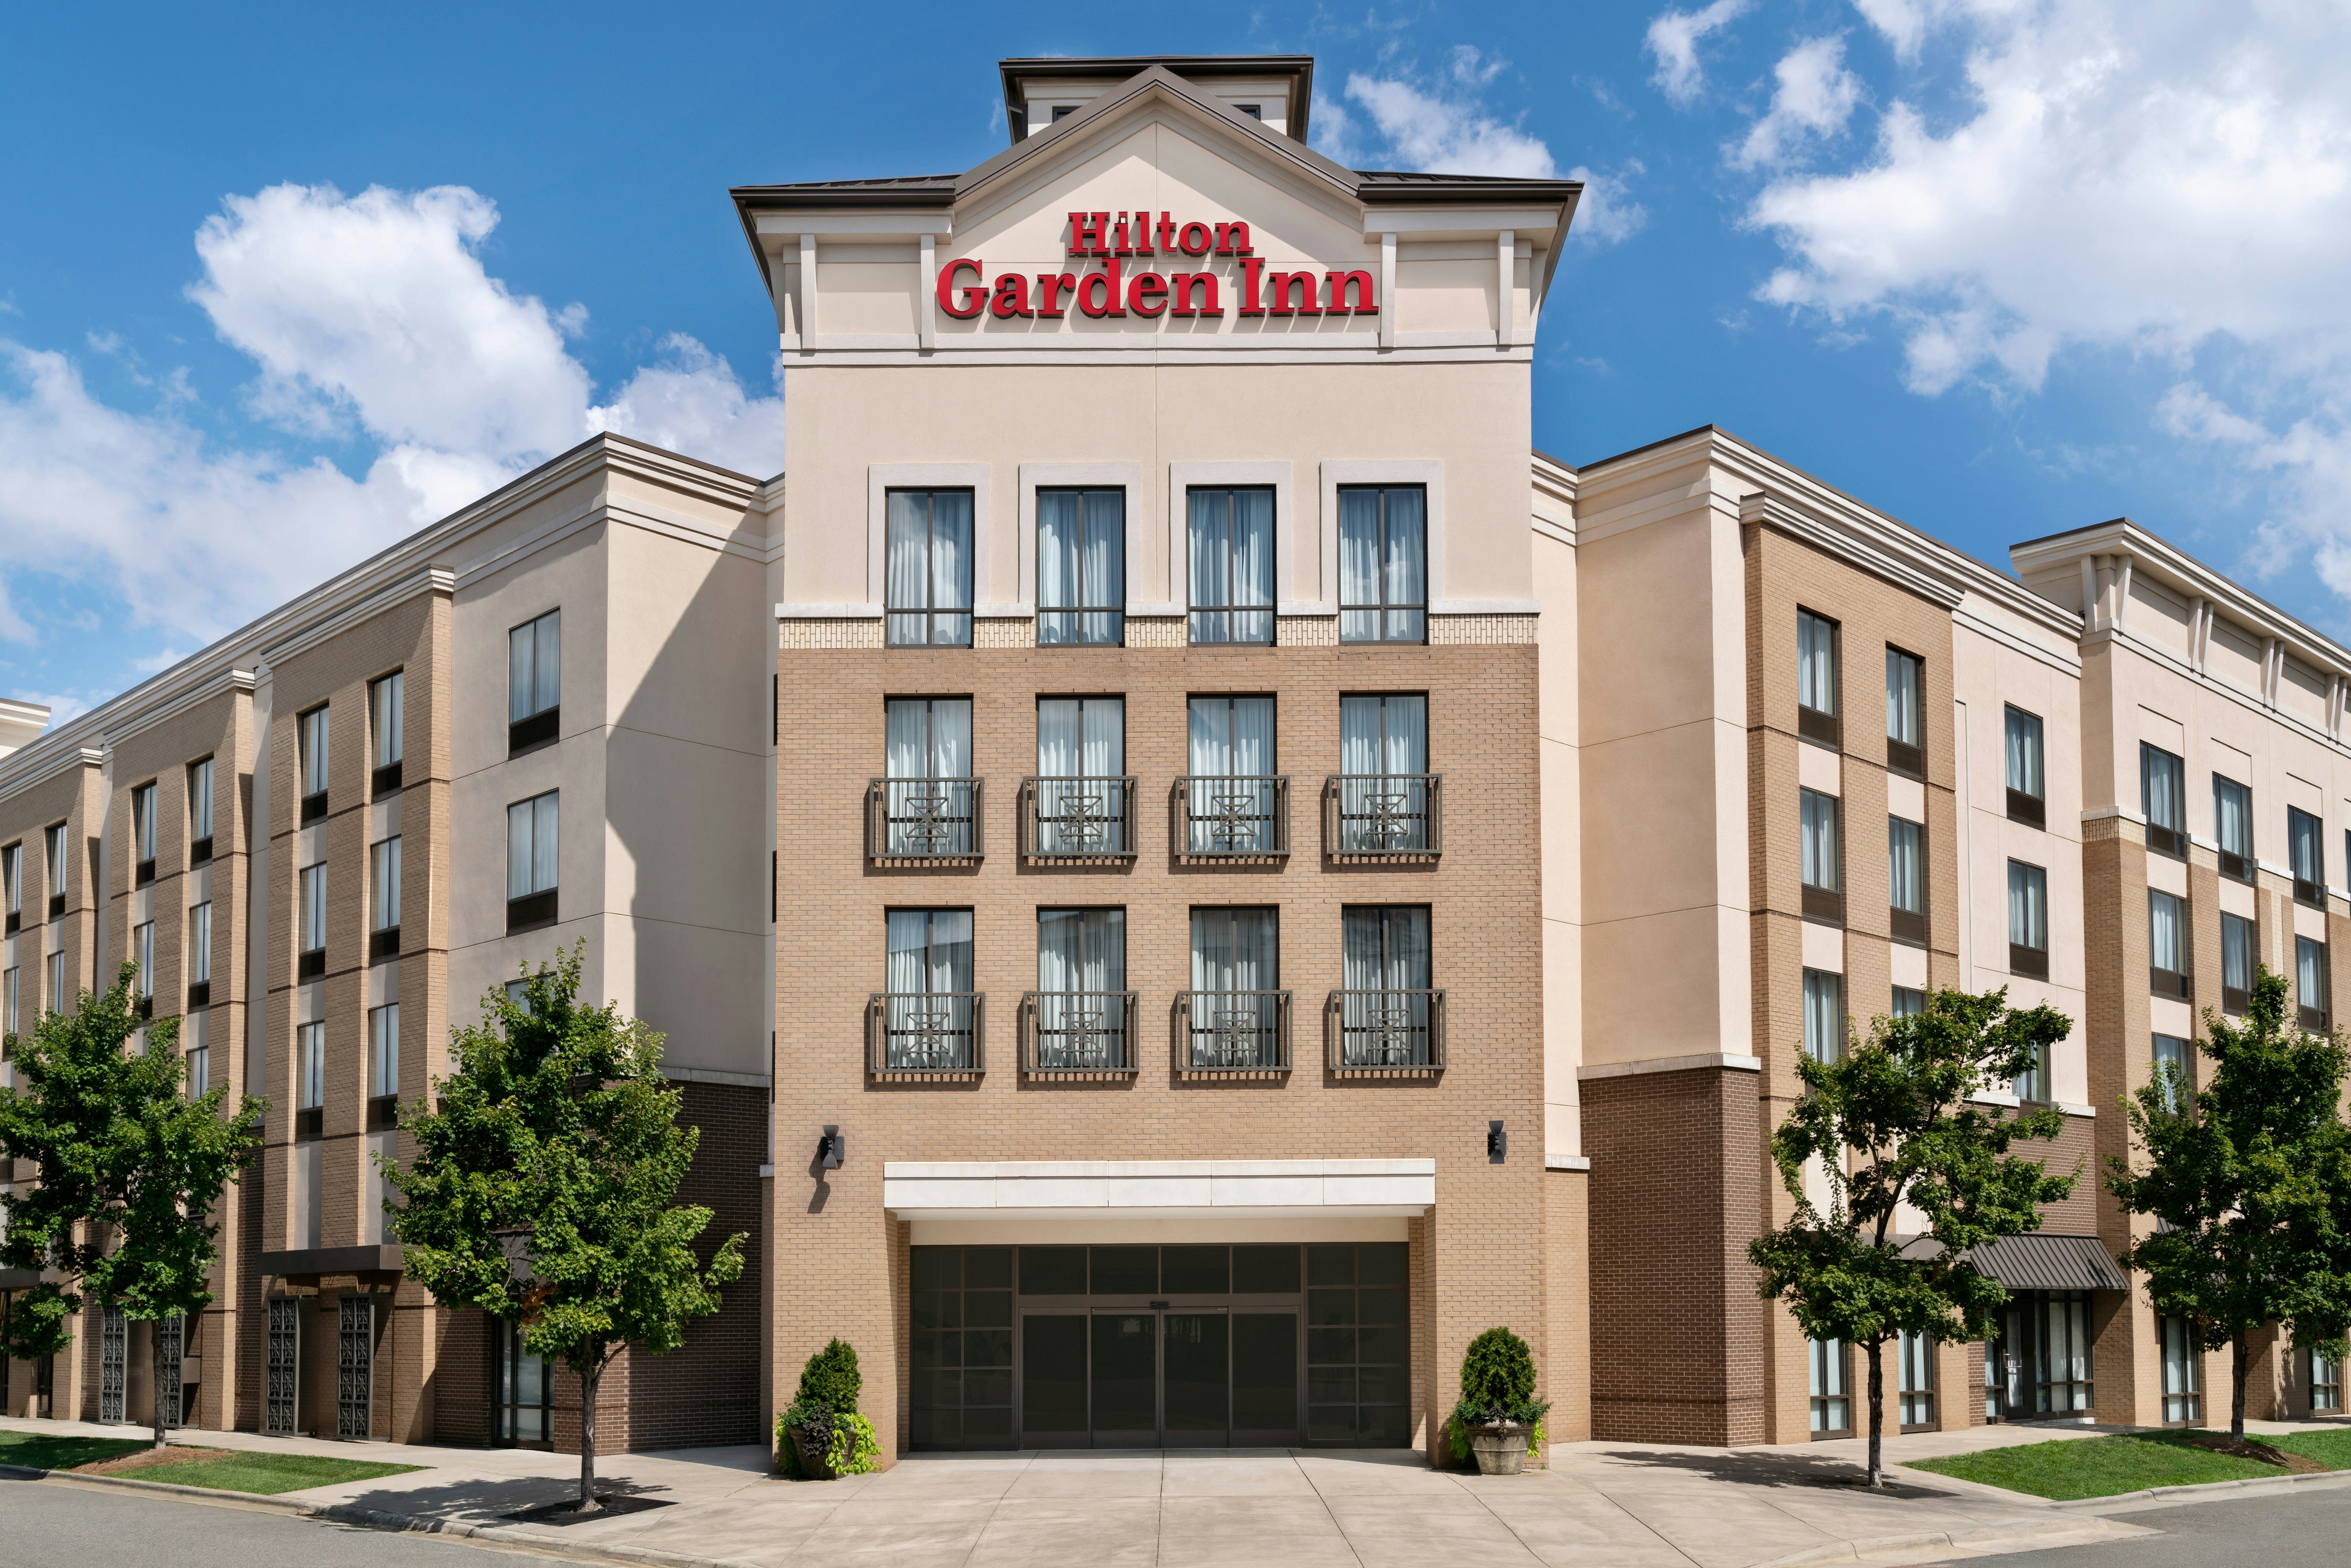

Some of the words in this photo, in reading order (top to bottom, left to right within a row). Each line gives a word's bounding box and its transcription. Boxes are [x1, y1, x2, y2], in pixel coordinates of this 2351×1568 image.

[1068, 211, 1254, 256] Hilton
[937, 258, 1224, 318] Garden
[1239, 257, 1380, 317] Inn
